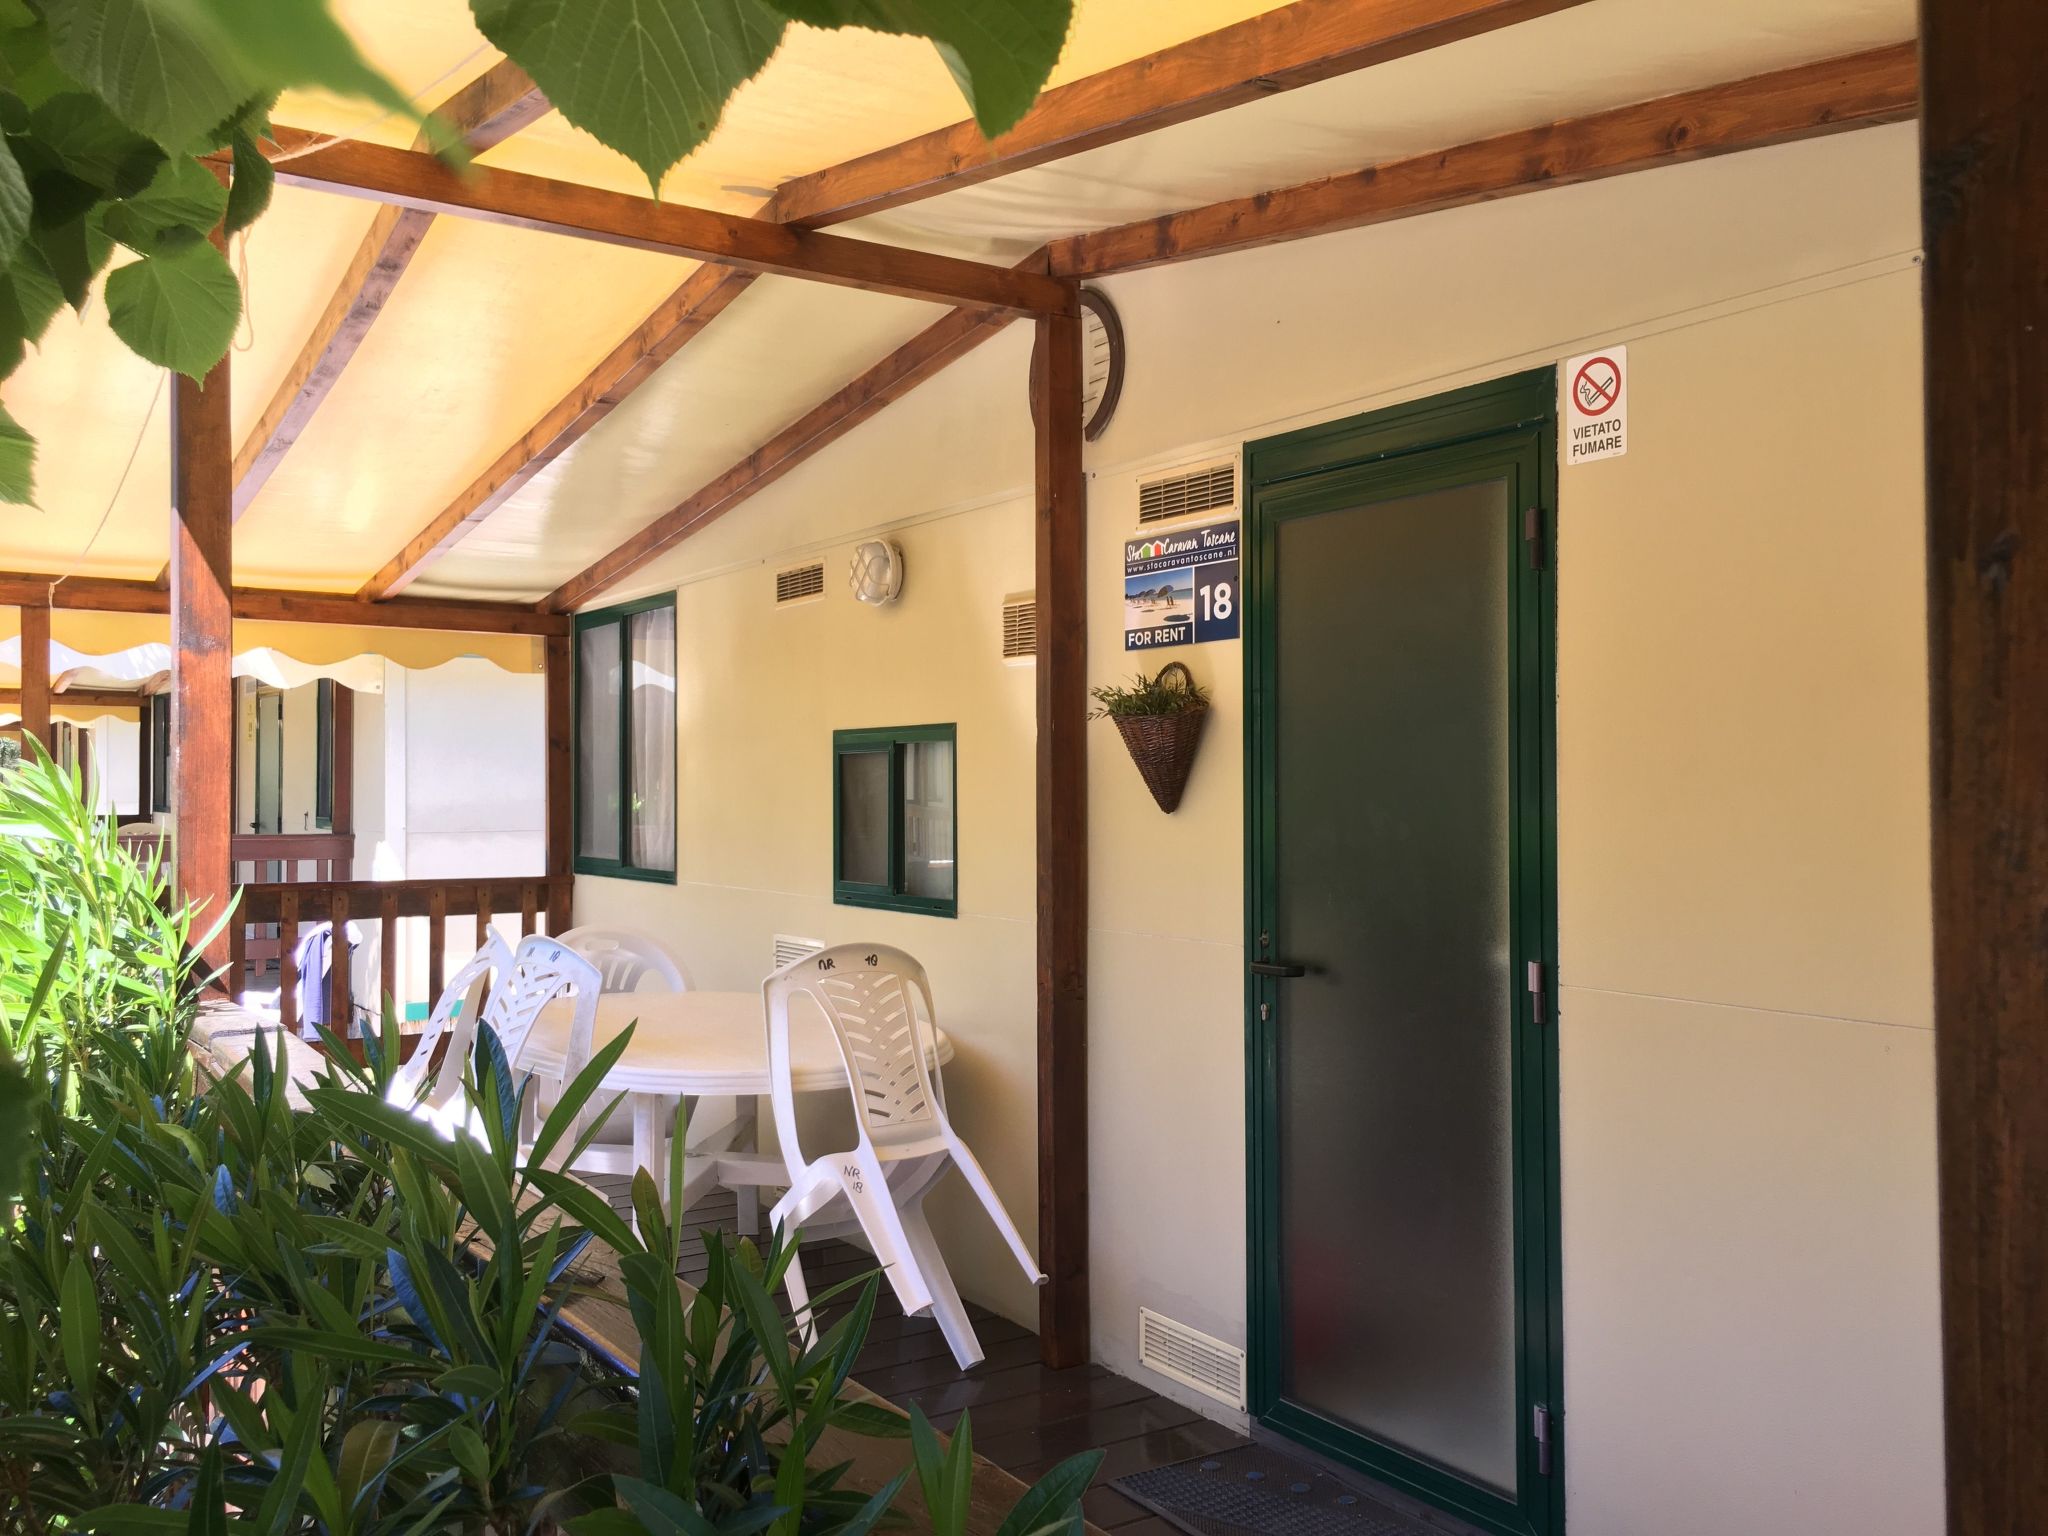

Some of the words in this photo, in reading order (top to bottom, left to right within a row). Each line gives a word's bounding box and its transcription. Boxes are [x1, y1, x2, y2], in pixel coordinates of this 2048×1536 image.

[1573, 419, 1621, 440] VIETATO
[1573, 436, 1622, 457] FUMARE
[1164, 538, 1198, 554] Caravan
[1201, 529, 1236, 548] Toscane
[1127, 547, 1236, 573] www.stacaravantoscane.nl
[1200, 582, 1232, 621] 18
[1128, 631, 1152, 647] FOR
[1155, 627, 1186, 644] RENT
[843, 1165, 861, 1180] NR
[852, 1181, 863, 1194] 18
